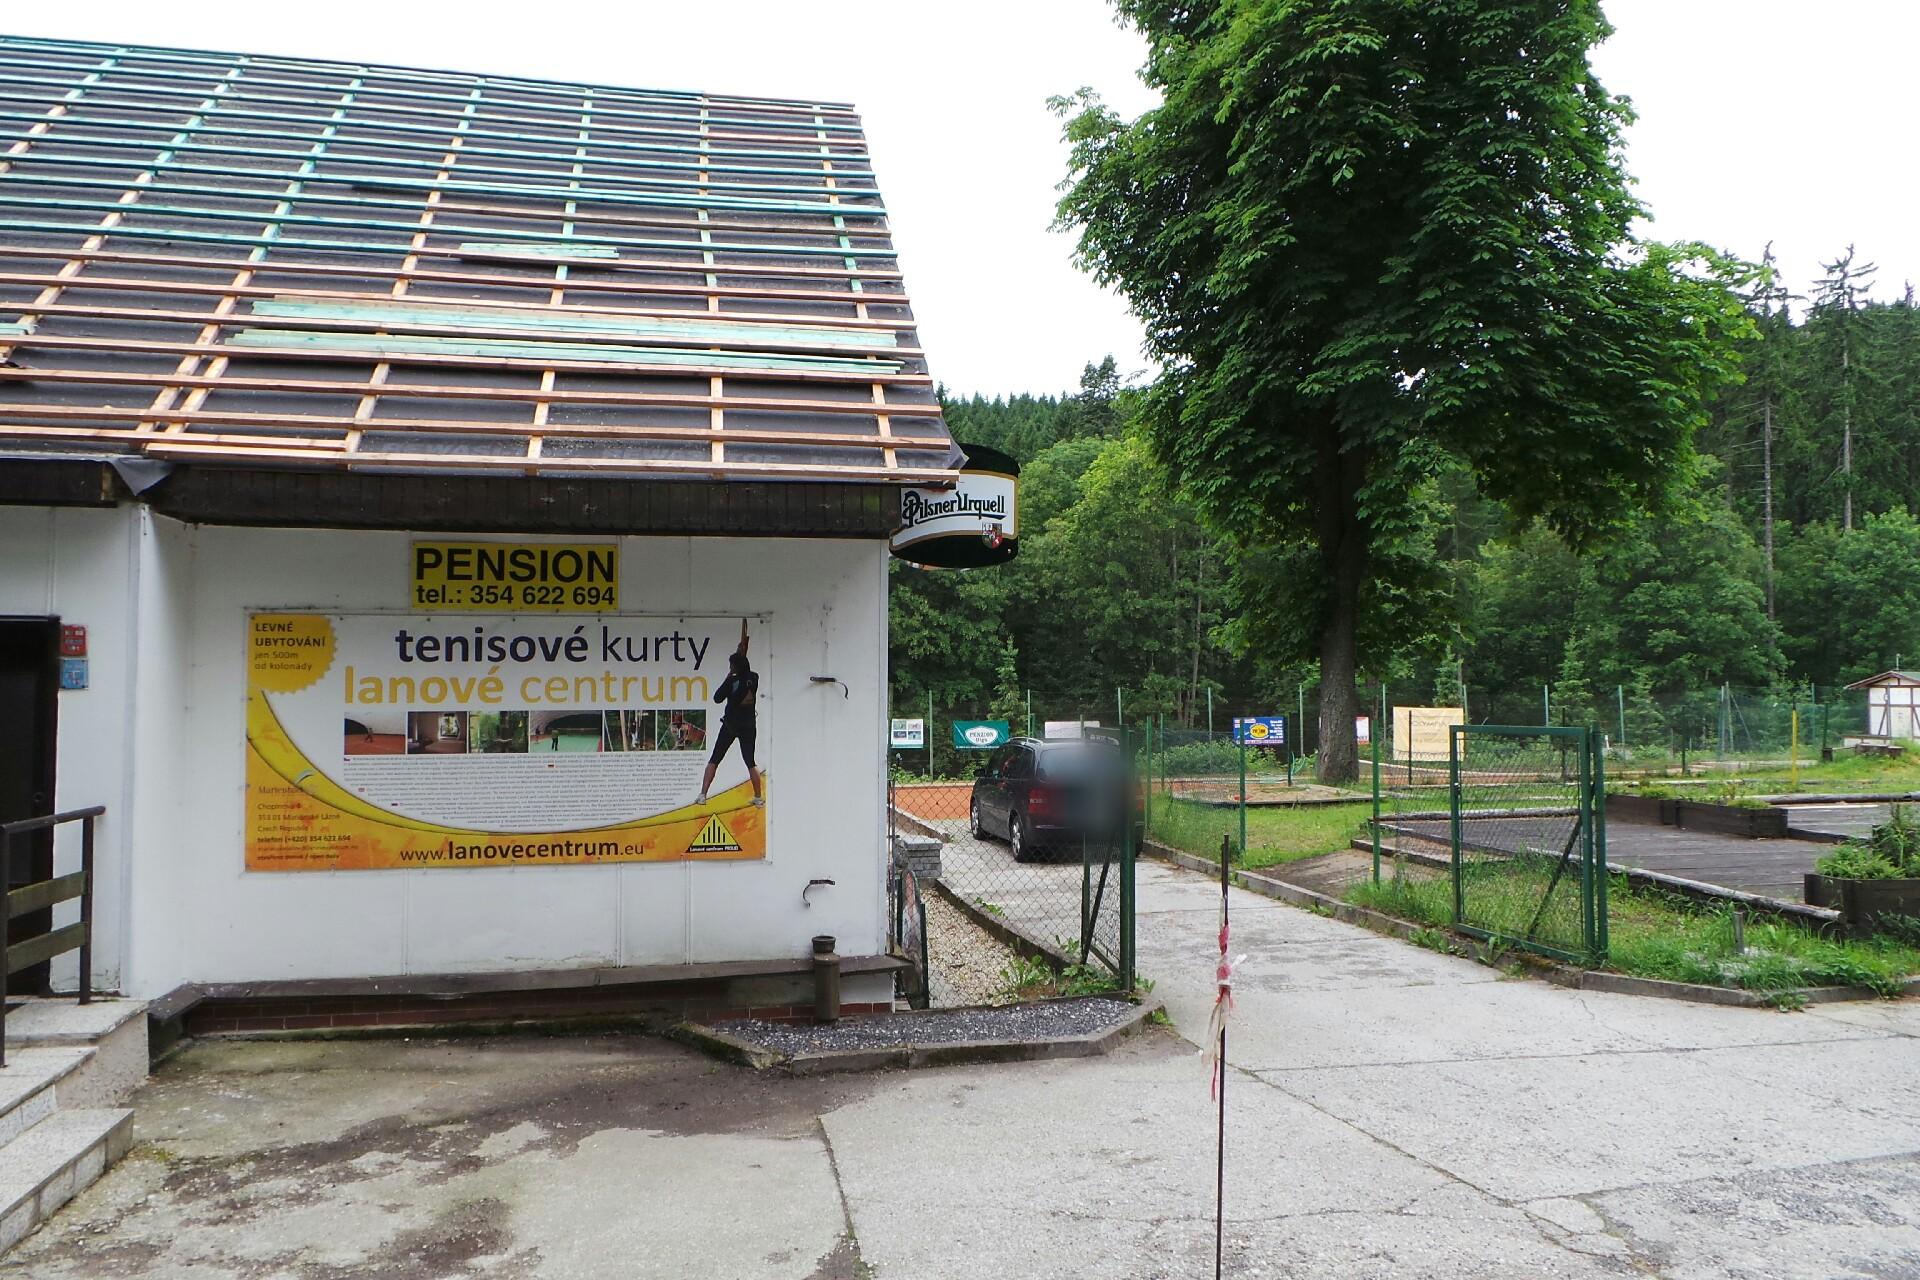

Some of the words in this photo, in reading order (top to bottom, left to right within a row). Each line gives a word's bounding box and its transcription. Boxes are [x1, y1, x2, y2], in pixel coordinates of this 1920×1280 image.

[901, 490, 958, 528] Pilsner
[956, 490, 1005, 520] Urquell
[415, 547, 614, 583] PENSION
[416, 584, 462, 604] tel.:
[470, 584, 514, 604] 354
[522, 585, 565, 605] 622
[572, 586, 615, 605] 694
[255, 622, 293, 632] LEVNÉ
[255, 635, 326, 647] UBYTOVÁNÍ
[395, 625, 588, 663] tenisové
[602, 625, 711, 671] kurty
[254, 662, 267, 670] od
[344, 665, 504, 705] lanové
[519, 670, 708, 704] centrum
[400, 840, 645, 861] www.lanovecentrum.eu
